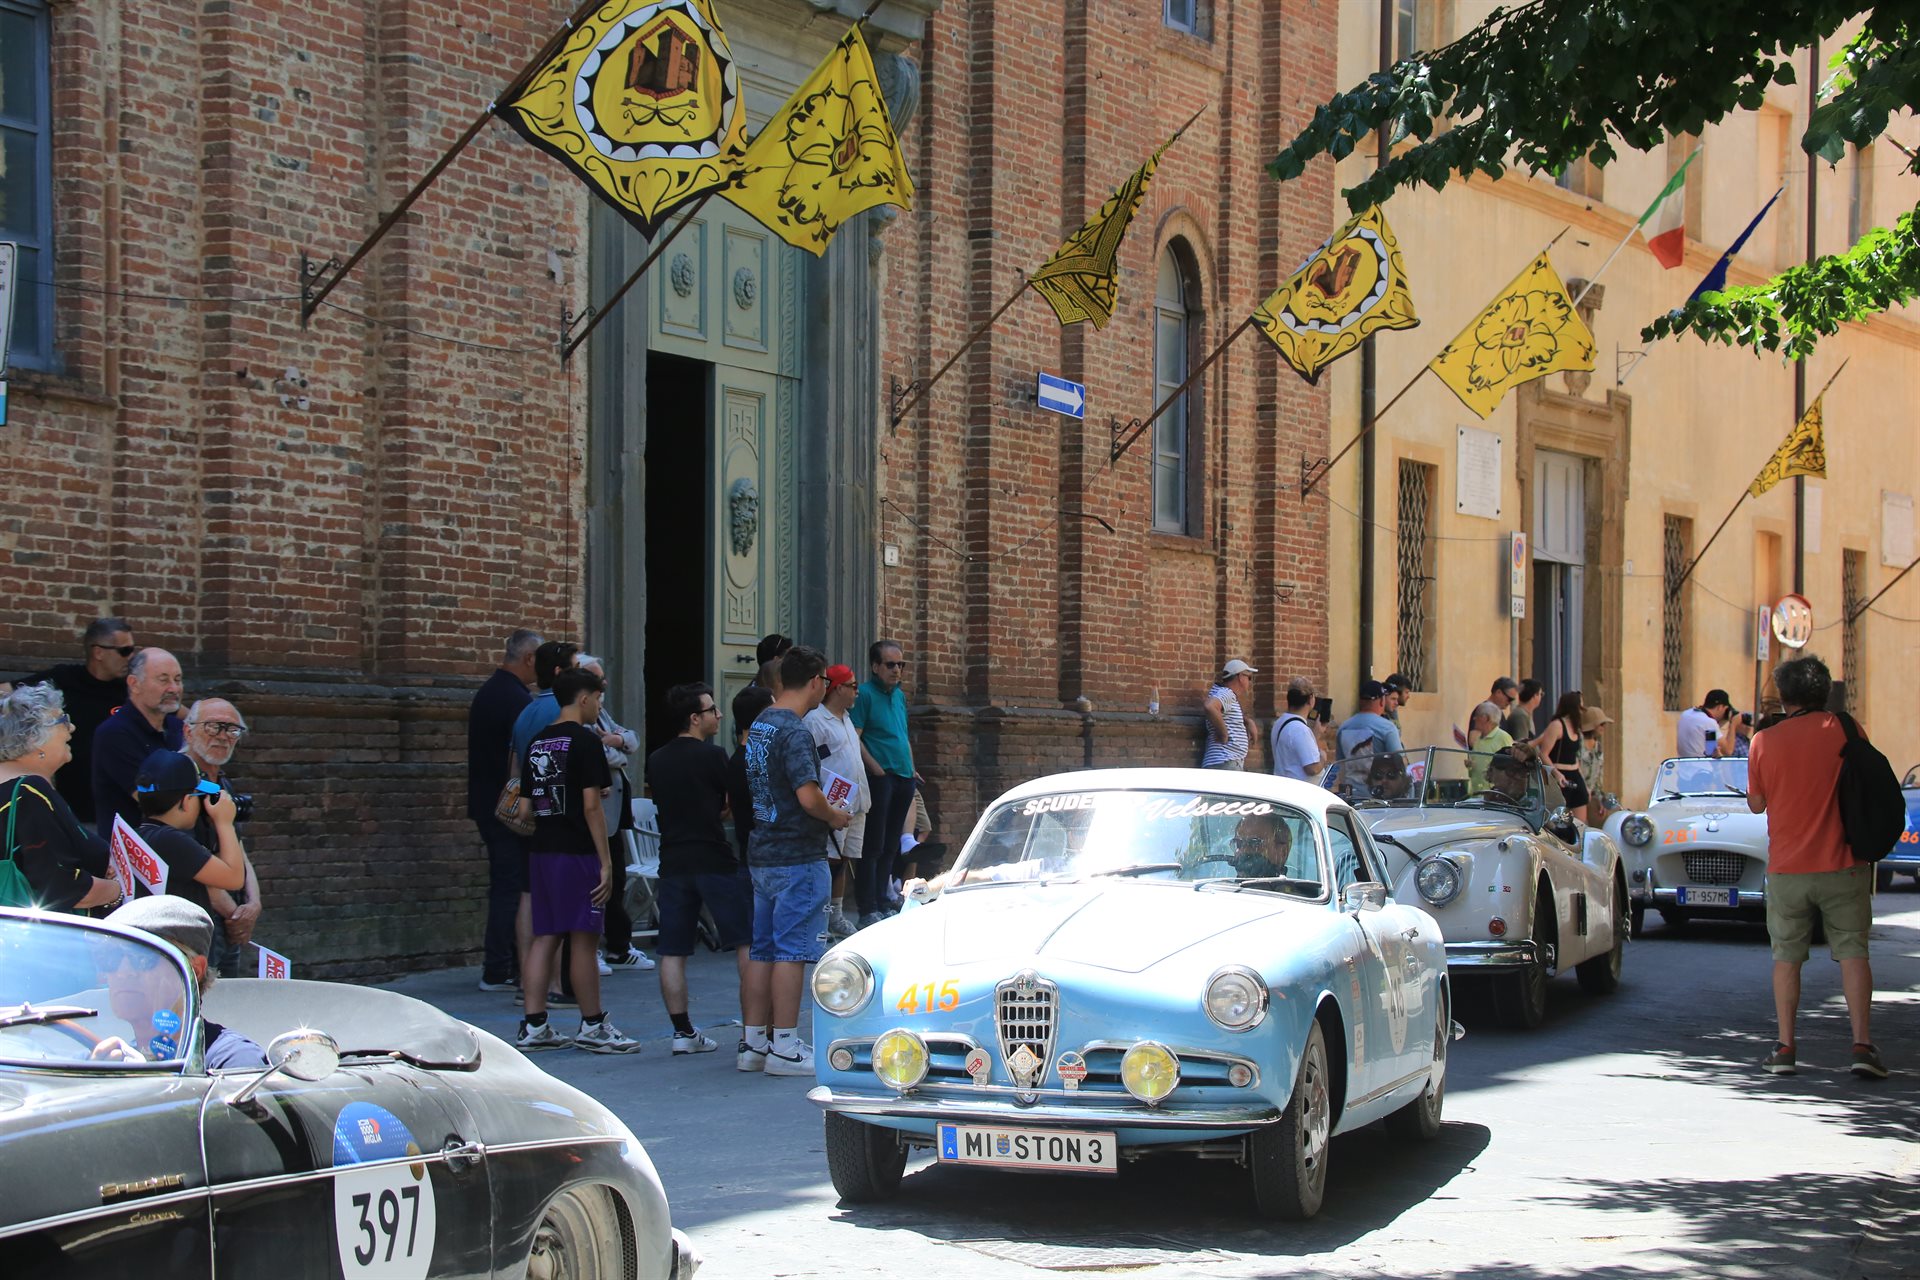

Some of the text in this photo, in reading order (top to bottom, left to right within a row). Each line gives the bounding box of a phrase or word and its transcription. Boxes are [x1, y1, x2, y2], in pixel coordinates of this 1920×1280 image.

[1663, 829, 1698, 845] 281
[1900, 831, 1919, 845] 86
[895, 979, 960, 1015] 415
[946, 1132, 1103, 1164] A MI STON 3
[352, 1185, 420, 1267] 397
